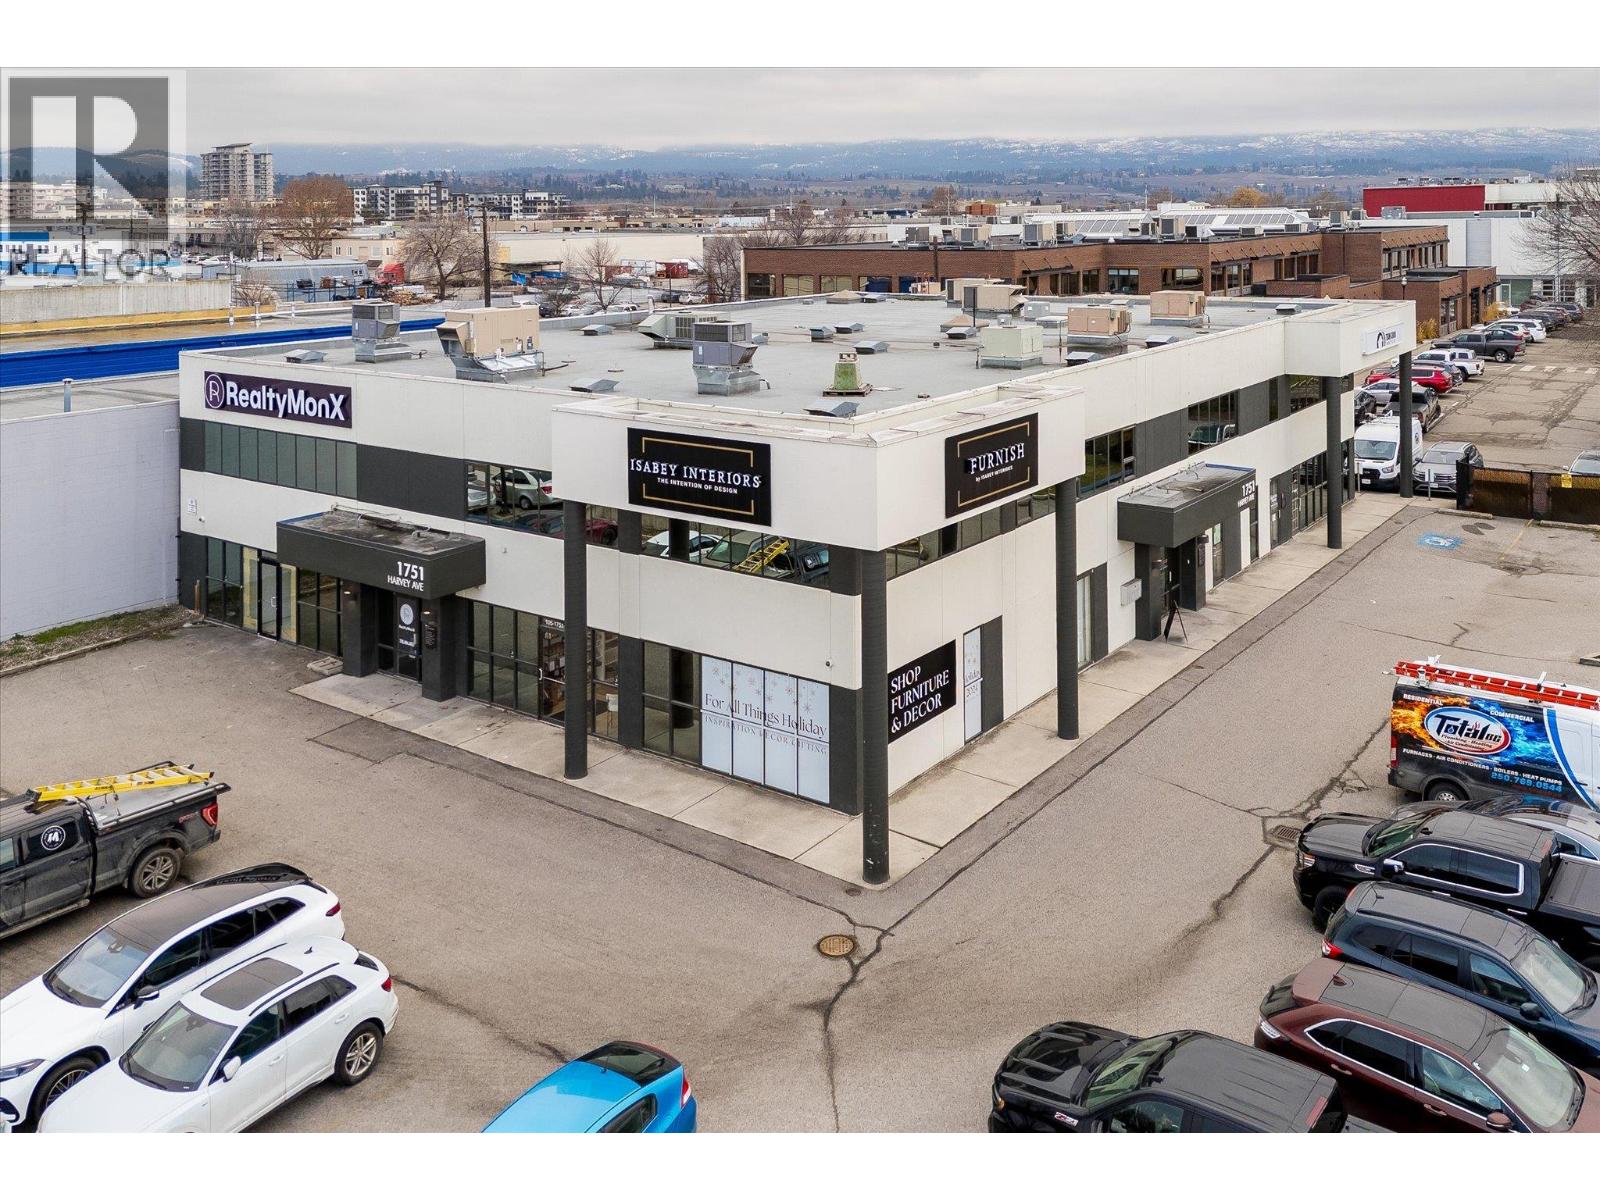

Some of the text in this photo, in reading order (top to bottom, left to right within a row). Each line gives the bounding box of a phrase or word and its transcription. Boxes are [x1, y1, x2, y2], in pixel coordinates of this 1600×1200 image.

[226, 381, 345, 421] RealtyMonX
[970, 442, 1025, 474] FURNISH
[630, 458, 762, 489] ISABEY INTERIORS
[657, 477, 669, 485] THE
[670, 479, 702, 489] INTENTION
[714, 485, 738, 494] DESIGN
[1242, 480, 1255, 497] 1751
[387, 575, 424, 592] HARVEY AVE
[397, 561, 424, 581] 1751
[891, 665, 921, 694] SHOP
[891, 669, 949, 714] FURNITURE
[891, 693, 942, 733] & DECOR
[1403, 693, 1444, 706] RESIDENTIAL
[705, 693, 724, 709] For
[742, 703, 780, 727] Things
[782, 713, 827, 739] Holiday
[1434, 714, 1490, 740] Total
[1489, 710, 1535, 723] COMMERCIAL
[1402, 748, 1433, 758] FURNACES
[1522, 772, 1540, 781] HEAT
